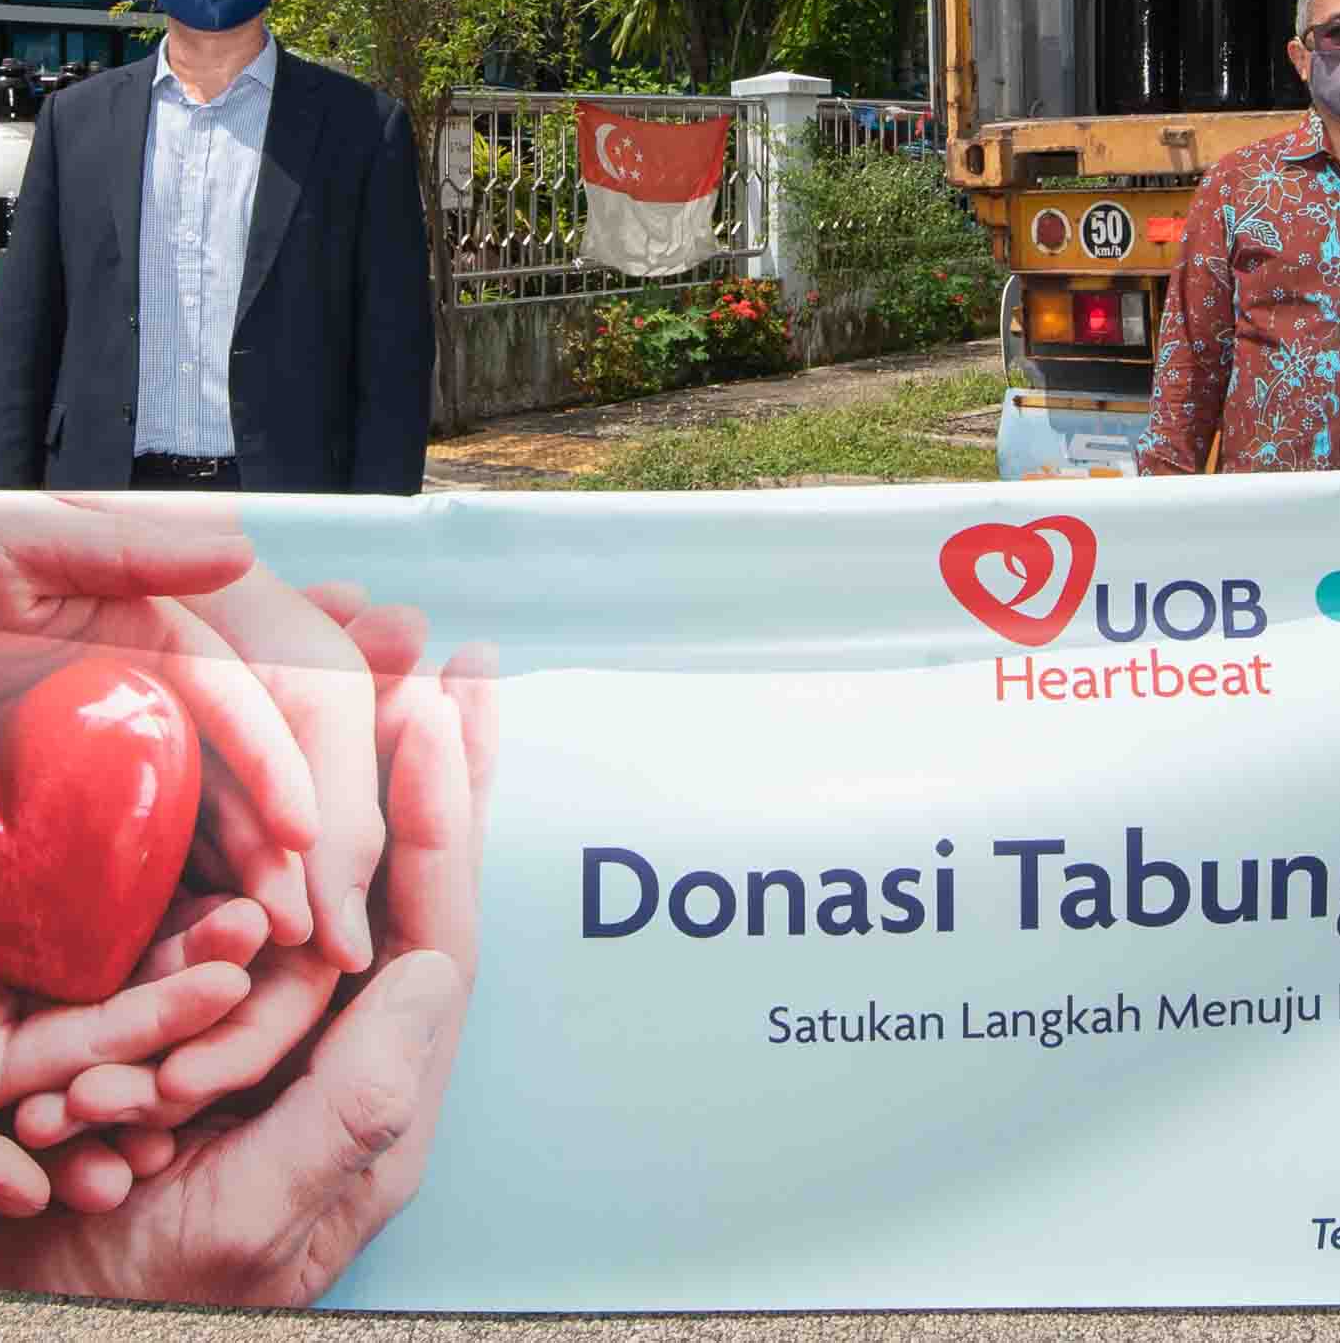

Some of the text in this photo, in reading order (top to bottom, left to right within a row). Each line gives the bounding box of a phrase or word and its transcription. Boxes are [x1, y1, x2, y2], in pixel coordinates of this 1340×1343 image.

[1090, 209, 1124, 245] 50
[1094, 244, 1123, 258] km/h
[1095, 578, 1269, 644] UOB
[994, 647, 1273, 702] Heartbeat
[581, 838, 956, 940] Donasi
[768, 1000, 945, 1045] Satukan
[961, 992, 1142, 1049] Langkah
[1157, 986, 1322, 1035] Menuju
